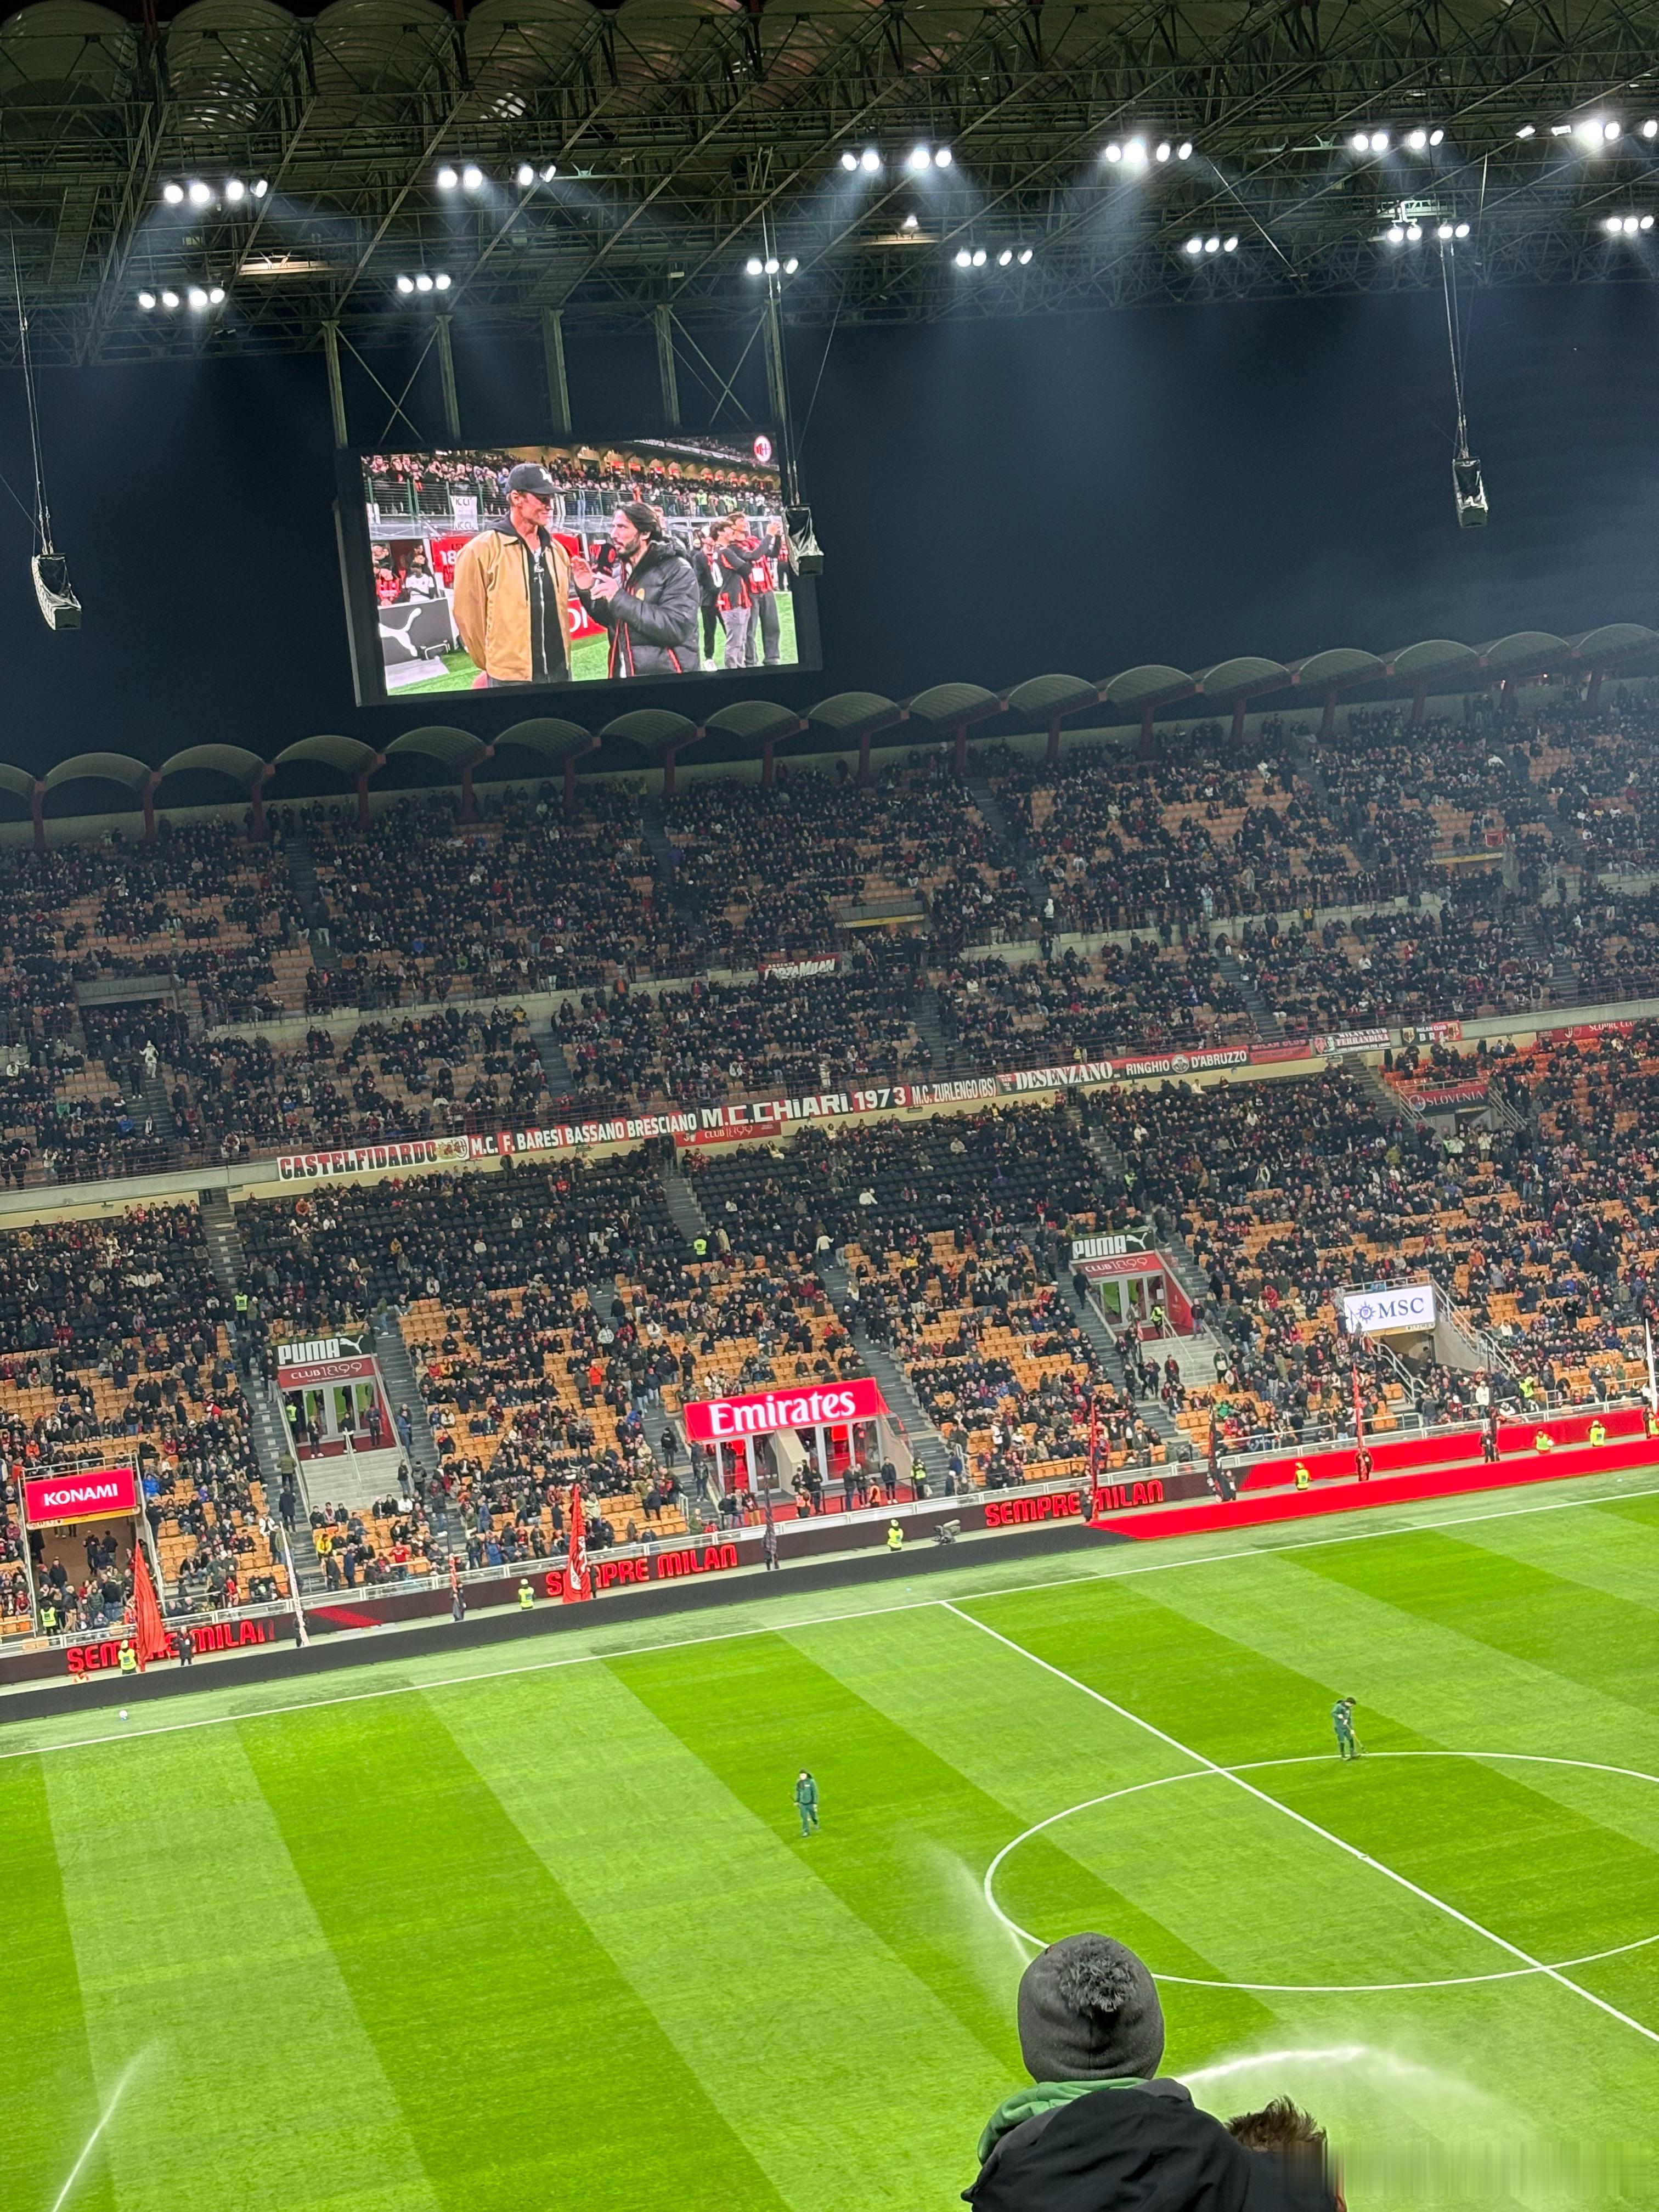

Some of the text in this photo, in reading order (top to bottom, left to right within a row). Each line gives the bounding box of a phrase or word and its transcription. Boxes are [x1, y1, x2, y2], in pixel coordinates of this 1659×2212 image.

[800, 958, 835, 977] MILAN
[1336, 1034, 1390, 1046] FERRANDINA
[1126, 1060, 1170, 1076] RINGHIO
[1191, 1050, 1247, 1068] D'ABRUZZO
[1015, 1062, 1113, 1091] DESENZANO
[854, 1086, 906, 1111] 1973
[912, 1086, 932, 1105] M.C.
[933, 1079, 978, 1103] ZURLENGO
[978, 1077, 996, 1098] (BS)
[1426, 1090, 1484, 1106] SLOVENIA
[471, 1113, 697, 1155] M.C. F. BARESI BASSANO BRESCIANO
[704, 1129, 725, 1139] CLUB
[280, 1141, 437, 1180] CASTELFIDARDO
[1072, 1234, 1127, 1260] PUMA
[1085, 1263, 1112, 1273] CLUB
[1111, 1257, 1148, 1270] 1899
[1378, 1297, 1424, 1319] MSC
[278, 1338, 340, 1365] PUMA
[291, 1369, 321, 1379] CLUB
[320, 1362, 362, 1377] 1899
[709, 1391, 856, 1435] Emirates
[44, 1483, 118, 1506] KONAMI
[984, 1492, 1081, 1527] SEMPRE
[545, 1544, 738, 1596] SPRE MILAN
